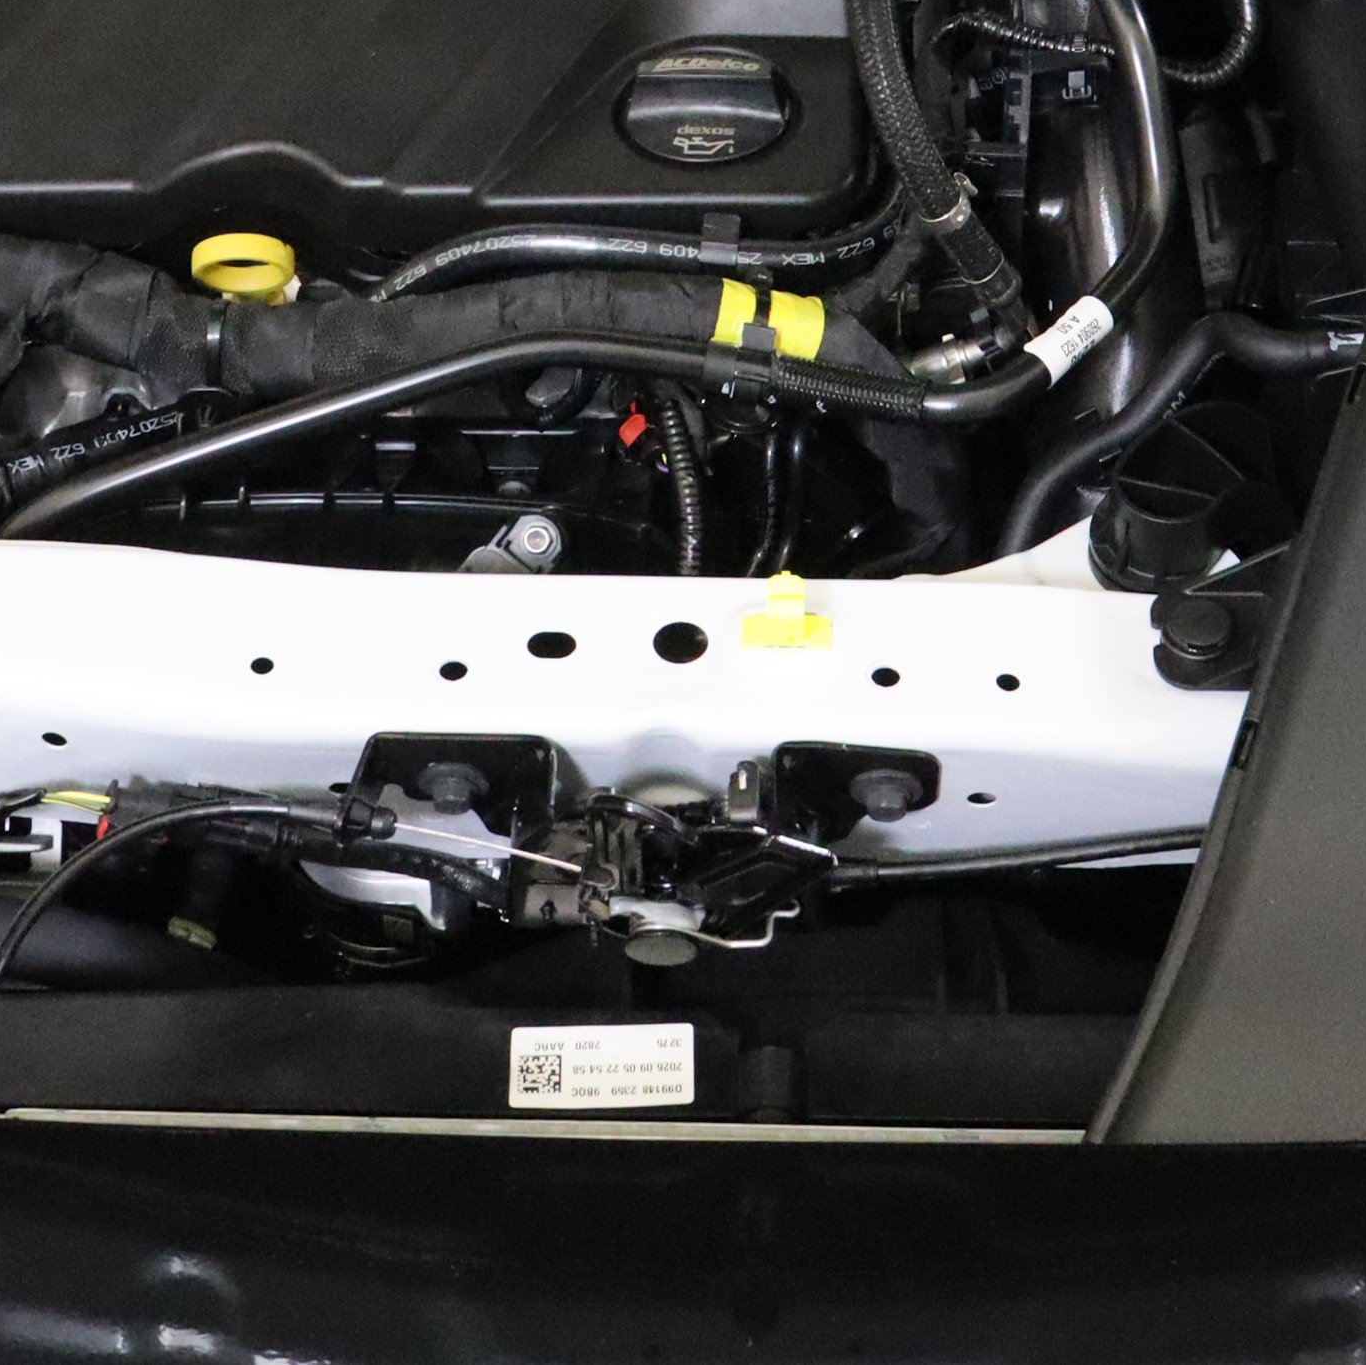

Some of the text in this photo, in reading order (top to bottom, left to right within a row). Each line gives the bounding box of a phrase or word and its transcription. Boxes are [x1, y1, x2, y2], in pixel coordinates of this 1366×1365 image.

[653, 57, 760, 73] ACDelco
[676, 124, 736, 135] dexos
[782, 250, 825, 266] MEX
[575, 1041, 600, 1051] 2820
[611, 1086, 636, 1096] 2359
